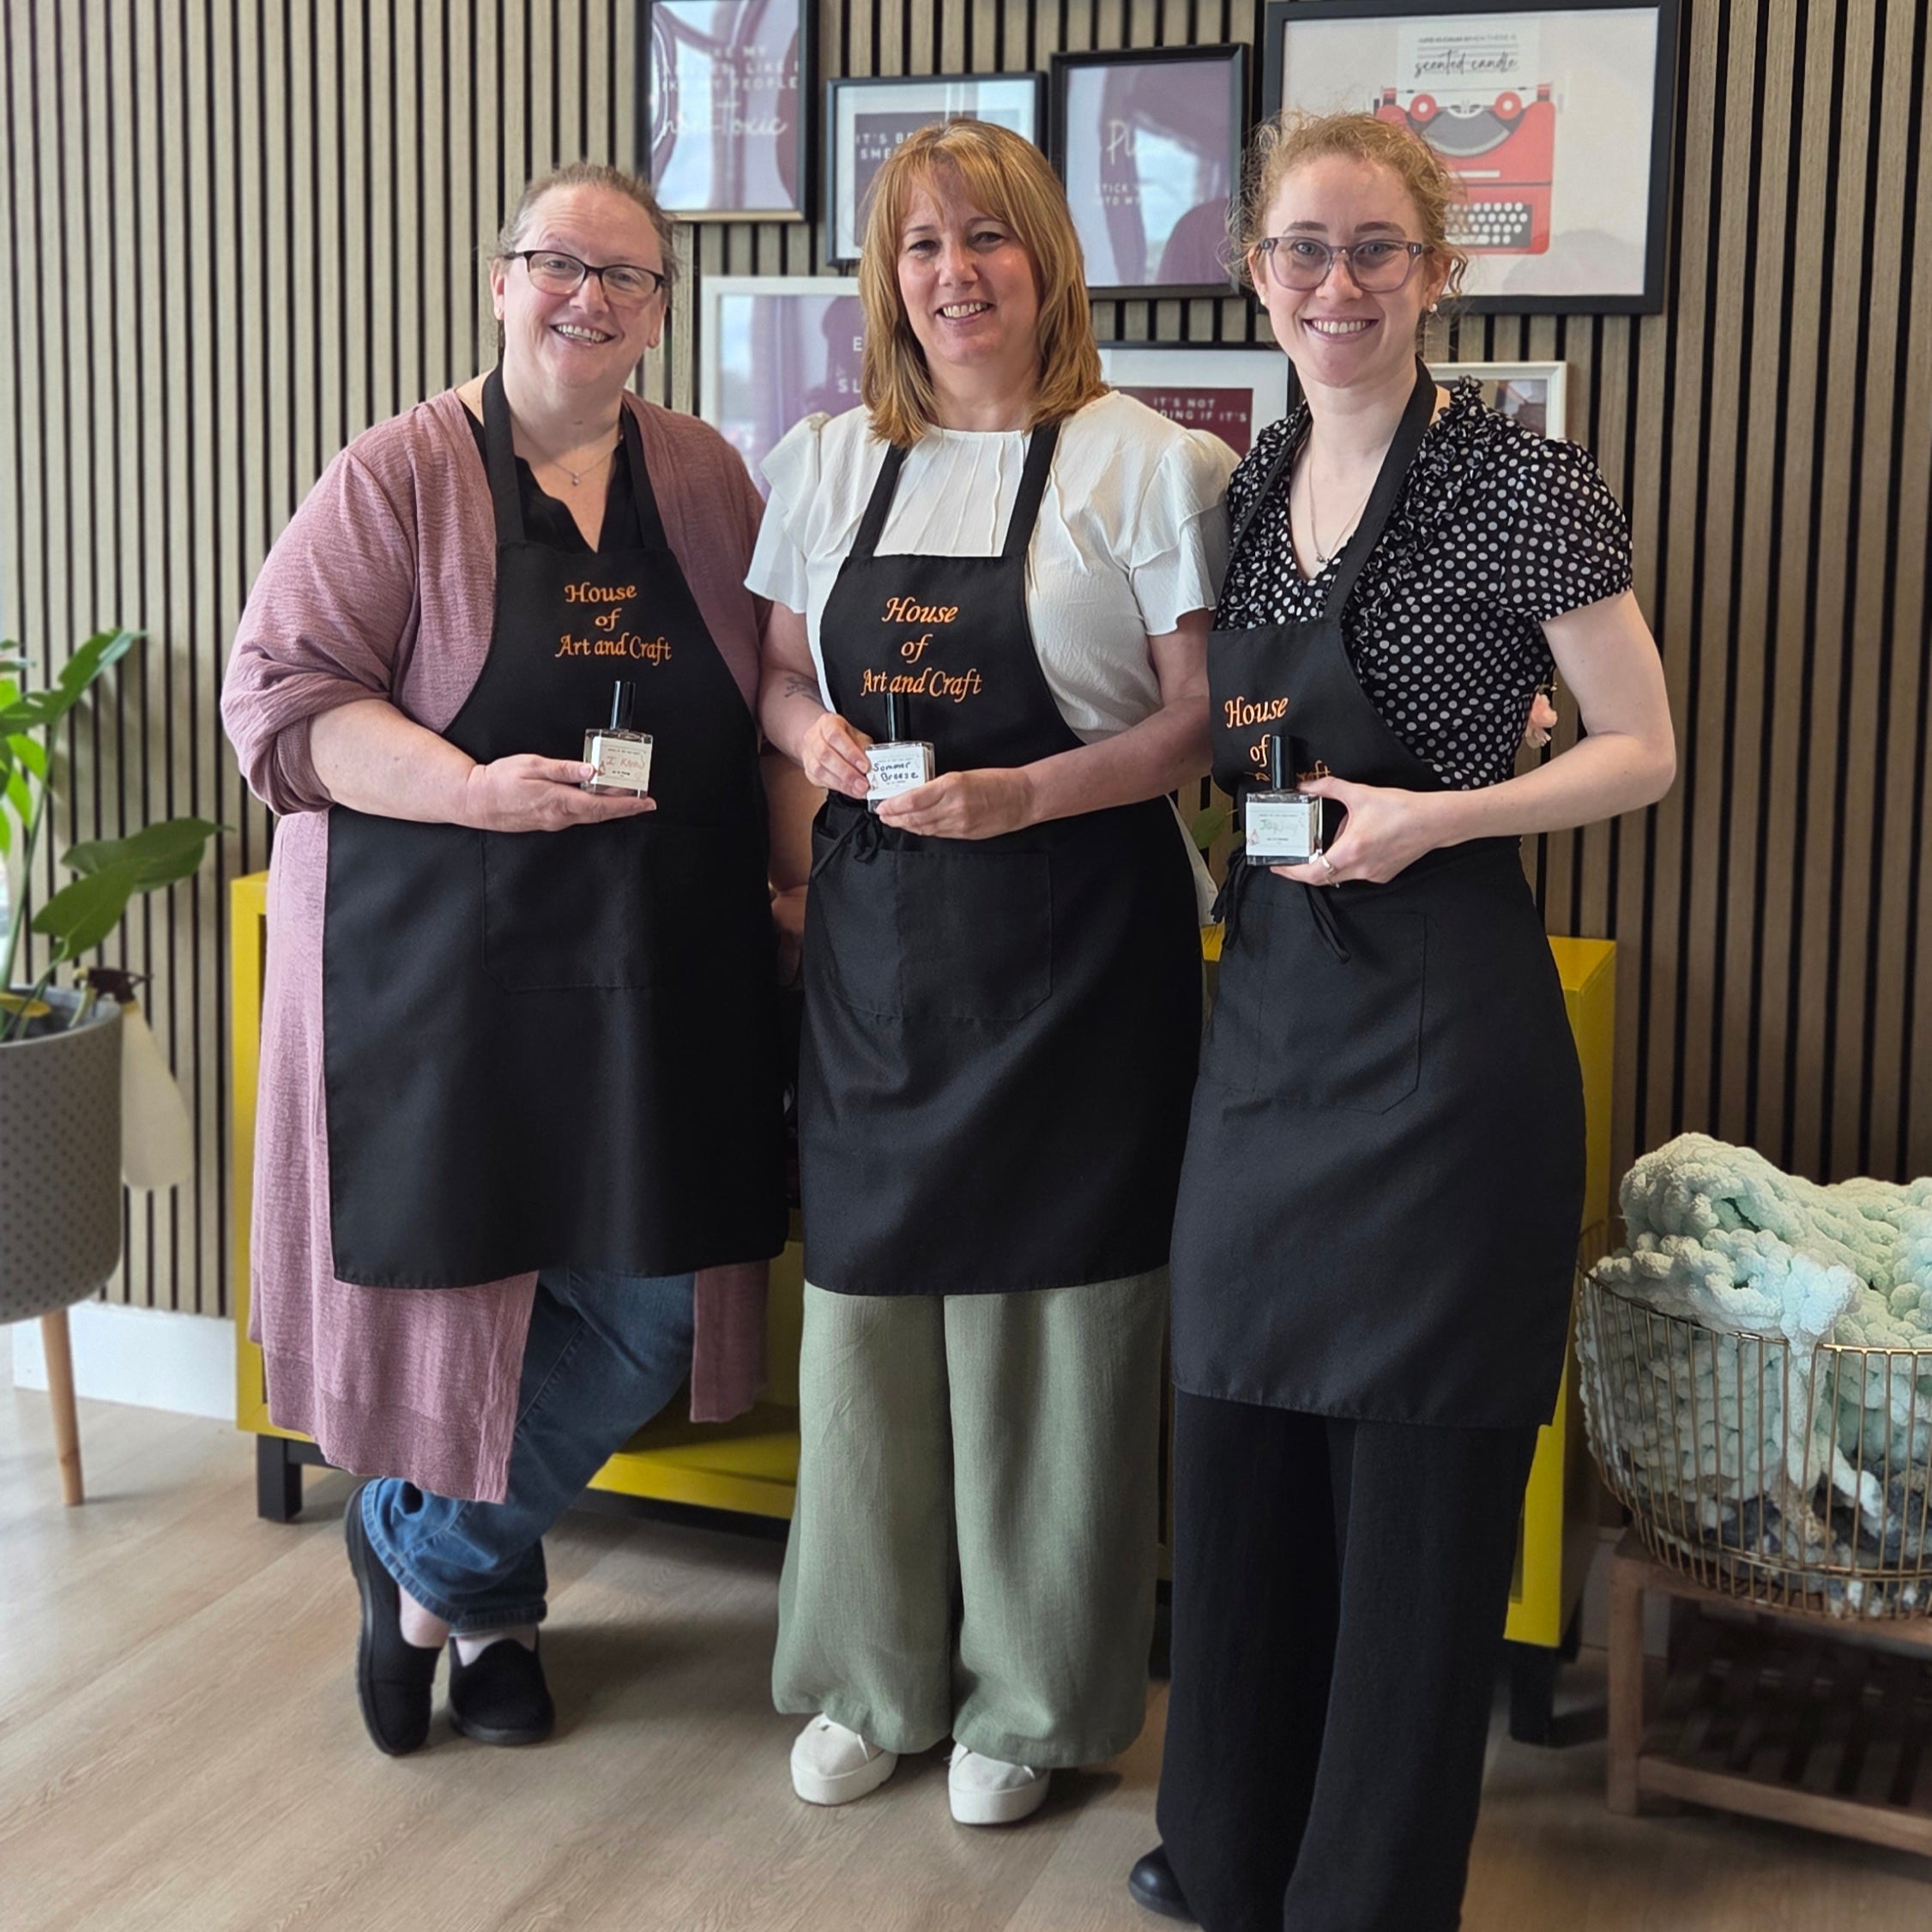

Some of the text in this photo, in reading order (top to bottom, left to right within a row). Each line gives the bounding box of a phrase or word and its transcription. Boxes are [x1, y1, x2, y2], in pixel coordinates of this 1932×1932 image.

[1154, 397, 1216, 409] IT'S NOT
[1200, 412, 1213, 421] IF
[1219, 413, 1247, 423] IT'S
[565, 582, 637, 603] House
[595, 607, 622, 631] of
[881, 596, 959, 623] House
[555, 632, 672, 667] Art and Craft
[901, 633, 933, 664] of
[860, 667, 982, 703] Art and Craft
[1224, 696, 1289, 728] House
[1250, 734, 1271, 768] of
